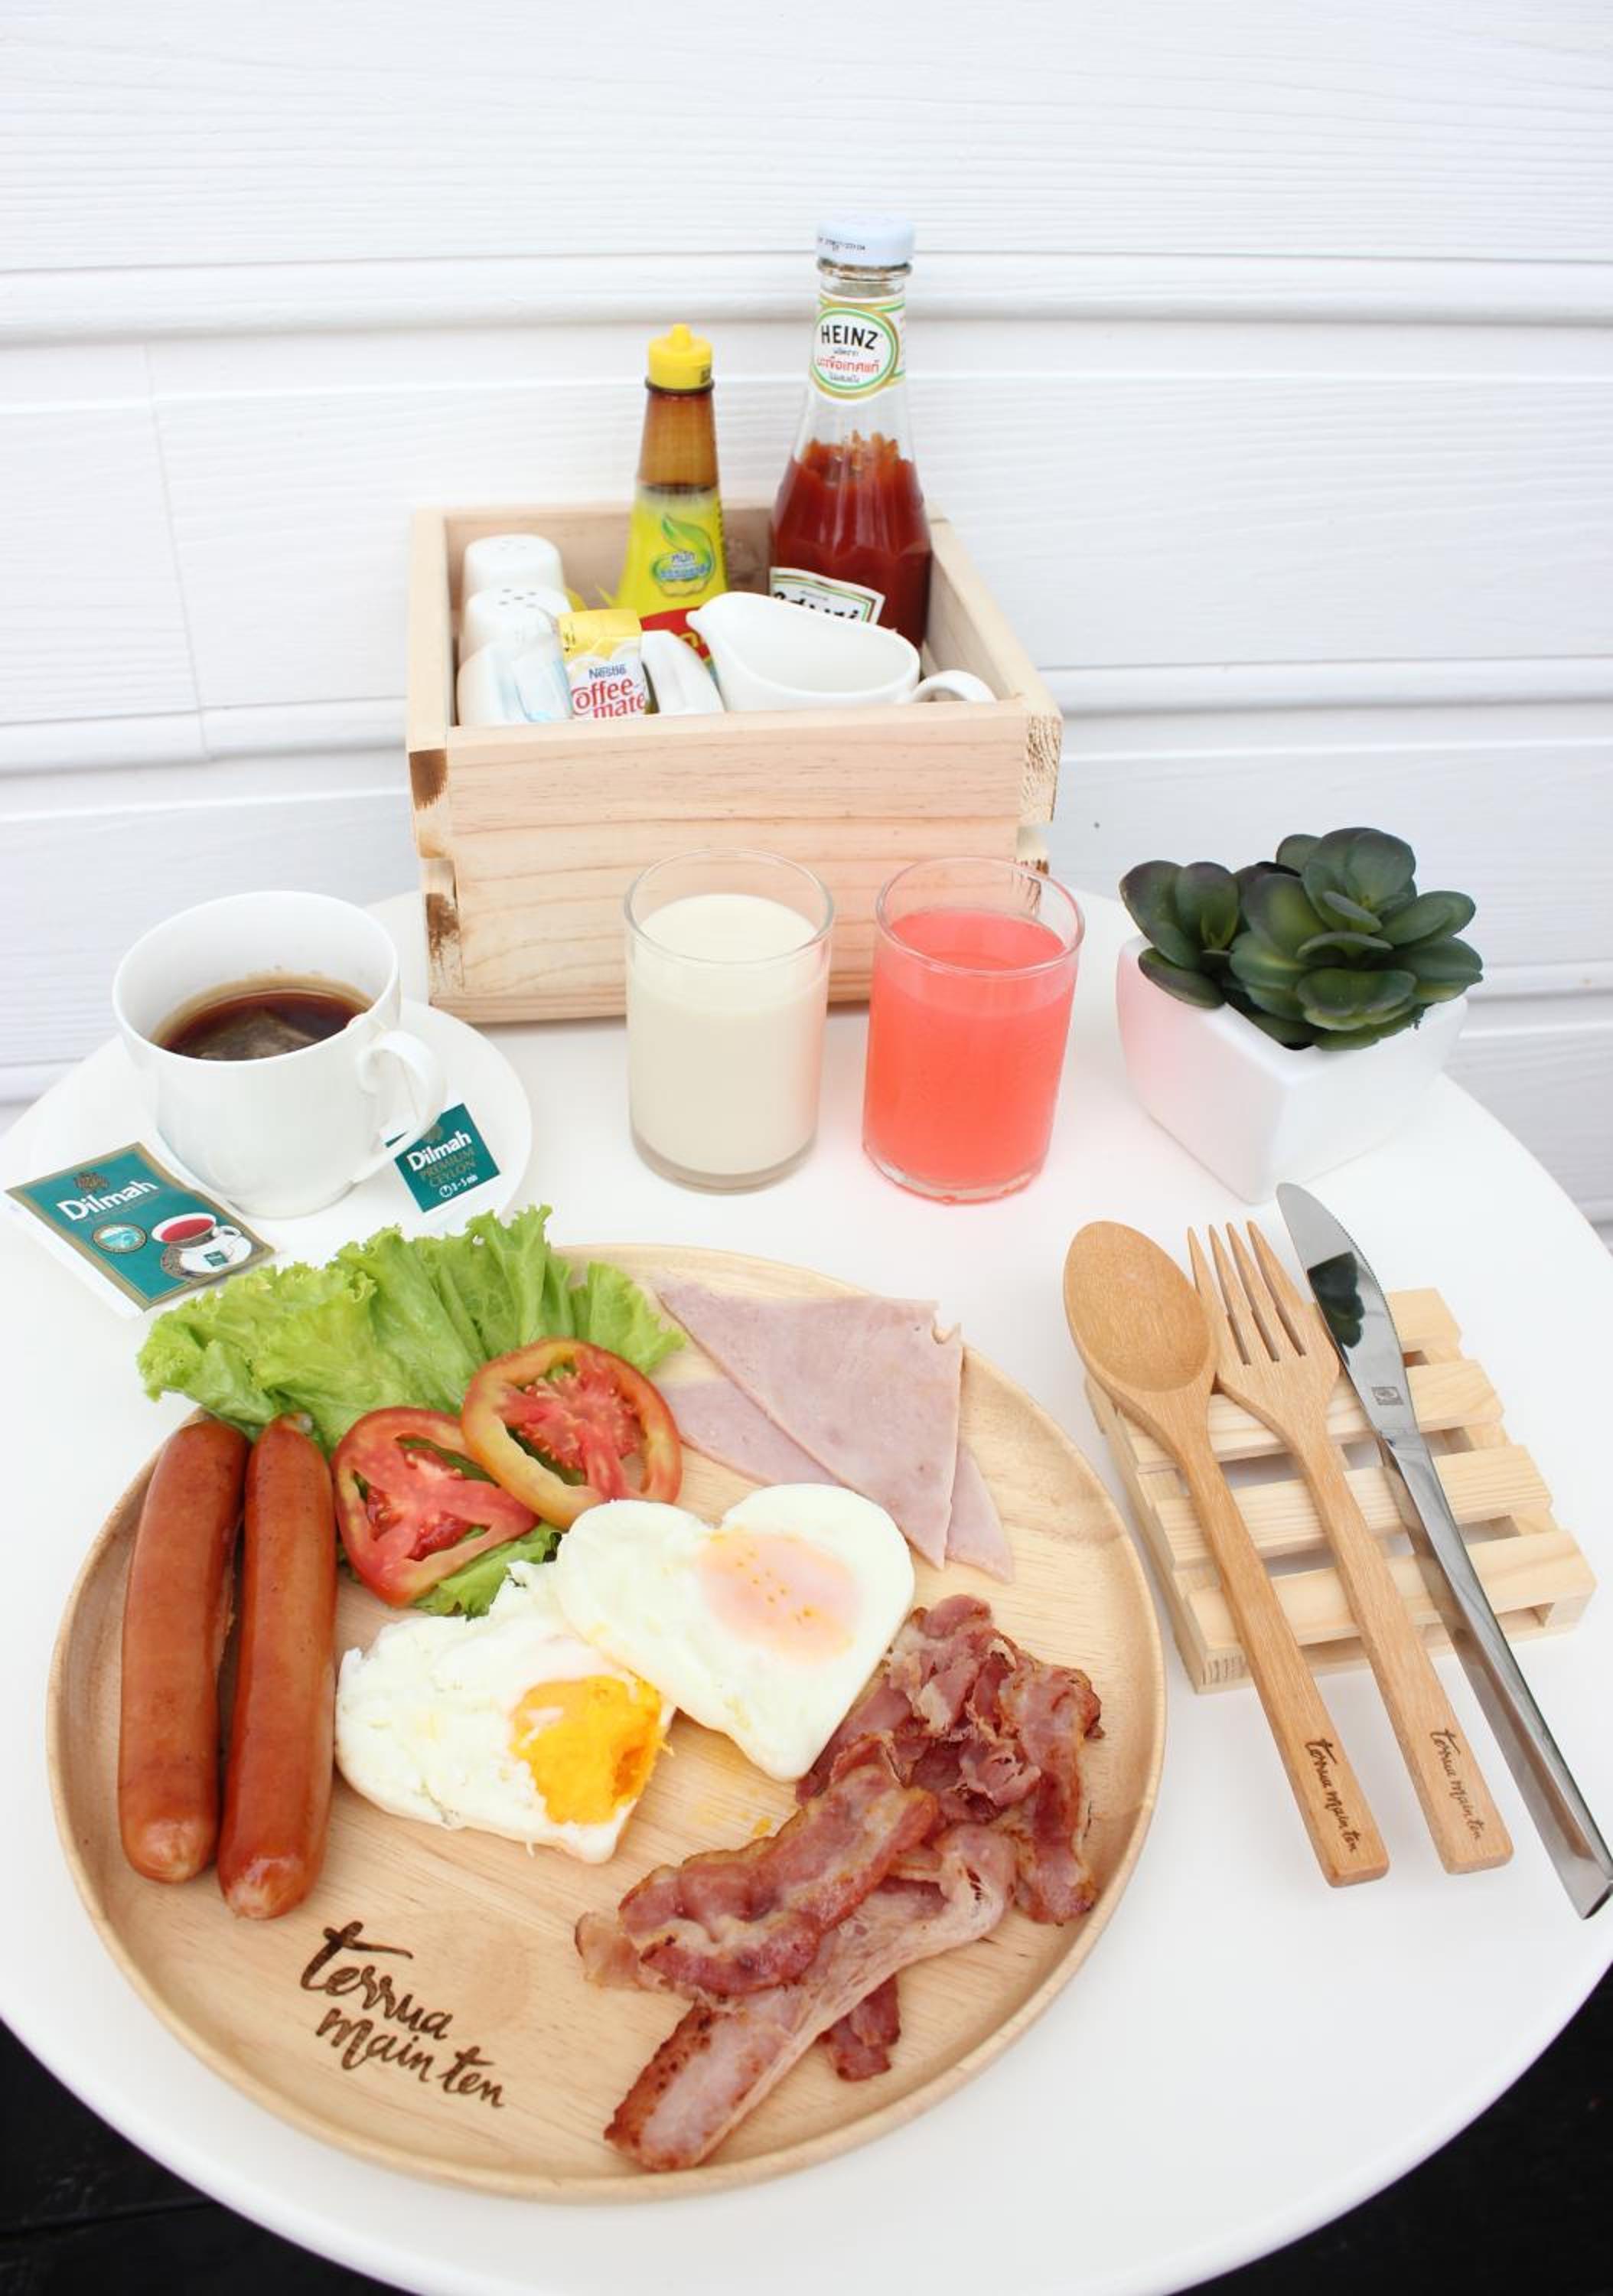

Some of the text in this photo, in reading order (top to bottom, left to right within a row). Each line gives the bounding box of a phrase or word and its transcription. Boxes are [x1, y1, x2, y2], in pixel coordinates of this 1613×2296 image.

[821, 325, 878, 350] HEINZ
[592, 692, 646, 718] mate
[406, 1130, 472, 1172] Dilmah
[56, 1180, 159, 1221] Dilmah
[437, 2046, 504, 2107] ten
